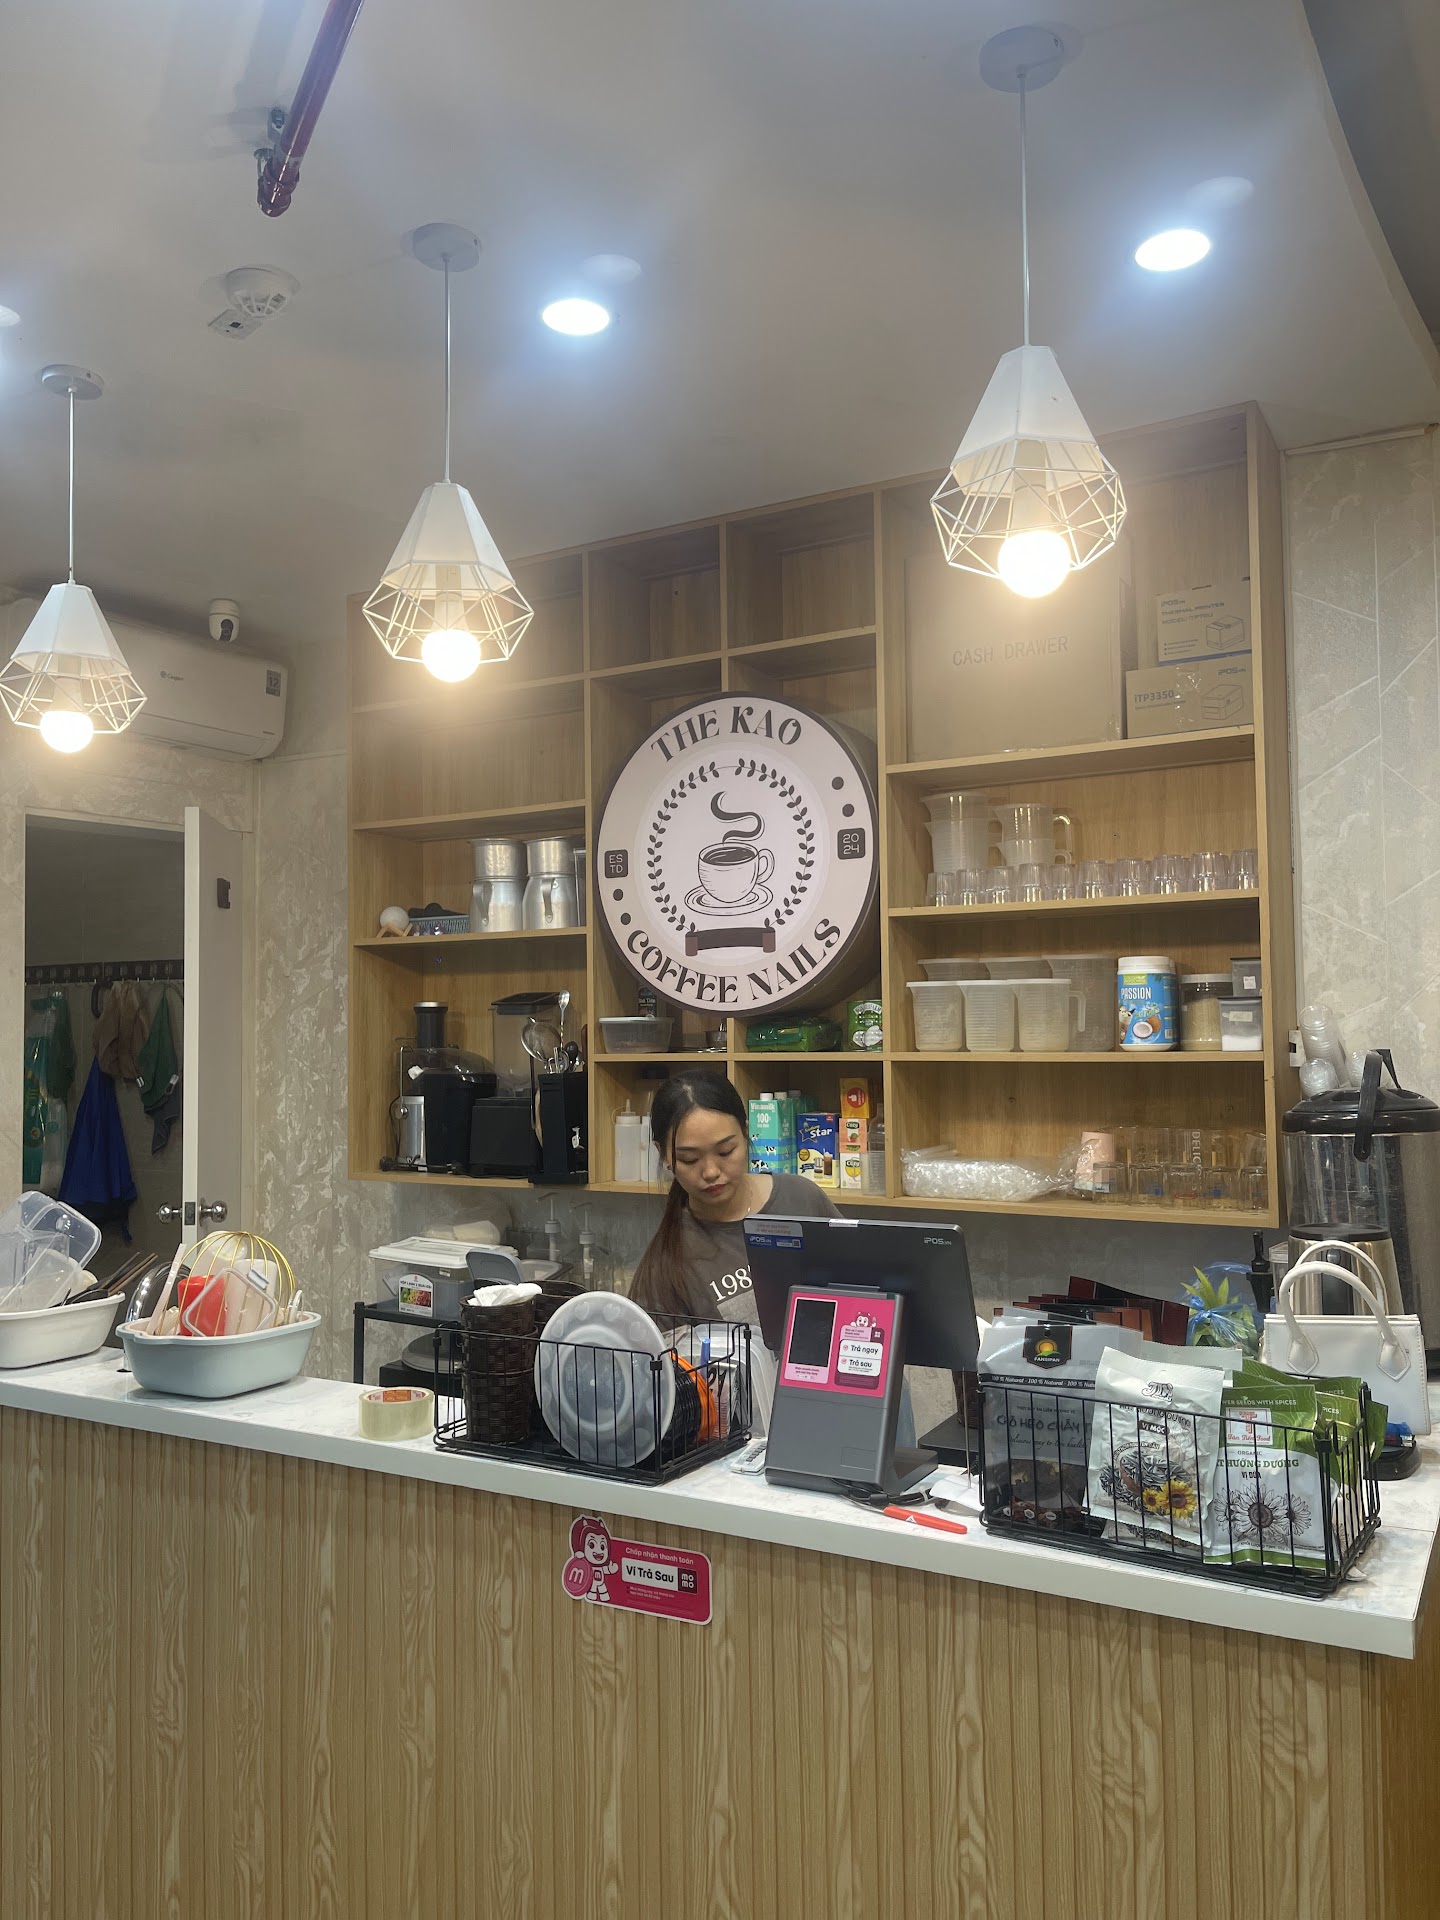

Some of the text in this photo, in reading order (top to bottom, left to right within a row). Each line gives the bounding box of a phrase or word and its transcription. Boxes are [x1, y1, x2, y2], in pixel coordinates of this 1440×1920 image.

[953, 636, 1068, 666] CASH DRAWER
[1134, 690, 1174, 703] iTP3350
[651, 706, 802, 762] THE KAO
[843, 833, 860, 844] 20
[843, 844, 860, 855] 24
[609, 854, 623, 863] ES
[610, 864, 623, 873] TD
[627, 918, 841, 1003] COFFEE NAILS
[1120, 986, 1152, 1000] PASSION
[810, 1128, 832, 1138] Star
[710, 1264, 752, 1302] 198
[1020, 1418, 1044, 1430] HEO
[625, 1547, 694, 1565] Chấp nhận thanh toán
[626, 1565, 674, 1583] Ví Trả Sau
